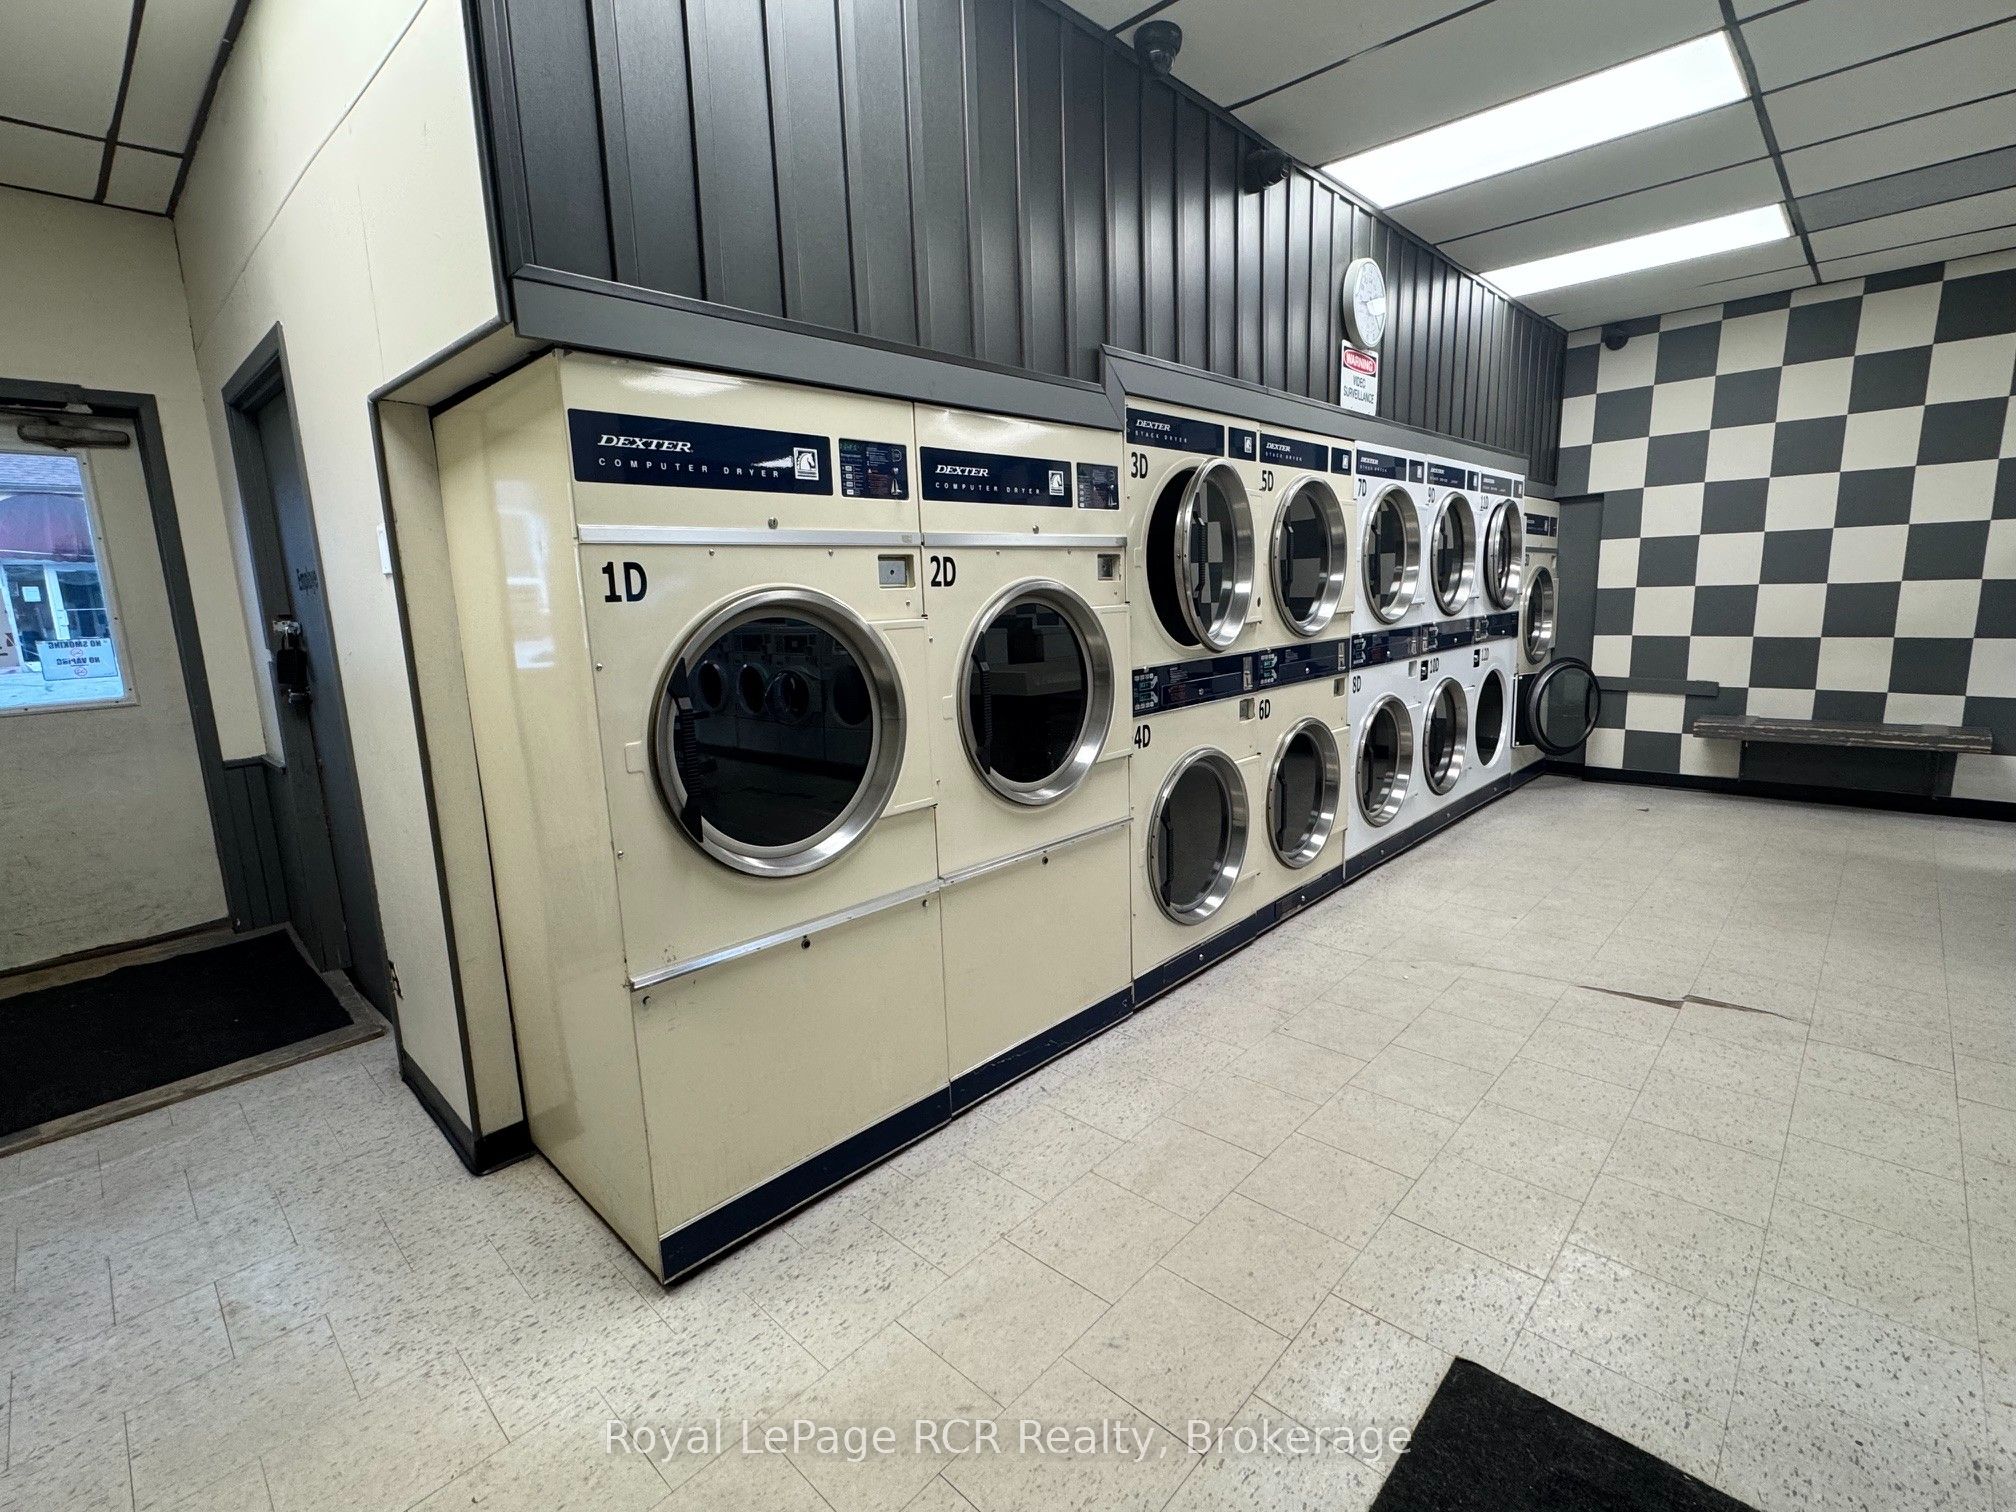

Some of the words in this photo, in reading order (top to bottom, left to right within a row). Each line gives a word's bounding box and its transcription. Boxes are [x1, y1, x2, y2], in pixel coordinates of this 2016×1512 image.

[1343, 385, 1375, 405] SURVEILLANCE
[1136, 419, 1171, 432] DEXTER
[597, 434, 693, 453] DEXTER
[1265, 442, 1291, 452] DEXTER
[598, 457, 709, 473] COMPUTER
[723, 466, 780, 479] DRYER
[934, 464, 990, 478] DEXTER
[1131, 452, 1149, 479] 3D
[935, 482, 998, 493] COMPUTER
[1006, 486, 1041, 495] DRYER
[1259, 470, 1274, 492] 5D
[1358, 478, 1367, 497] 7D
[930, 555, 957, 588] 2D
[601, 561, 648, 603] 1D
[1352, 675, 1362, 694] 8D
[1258, 699, 1271, 720] 6D
[1133, 724, 1151, 750] 4D
